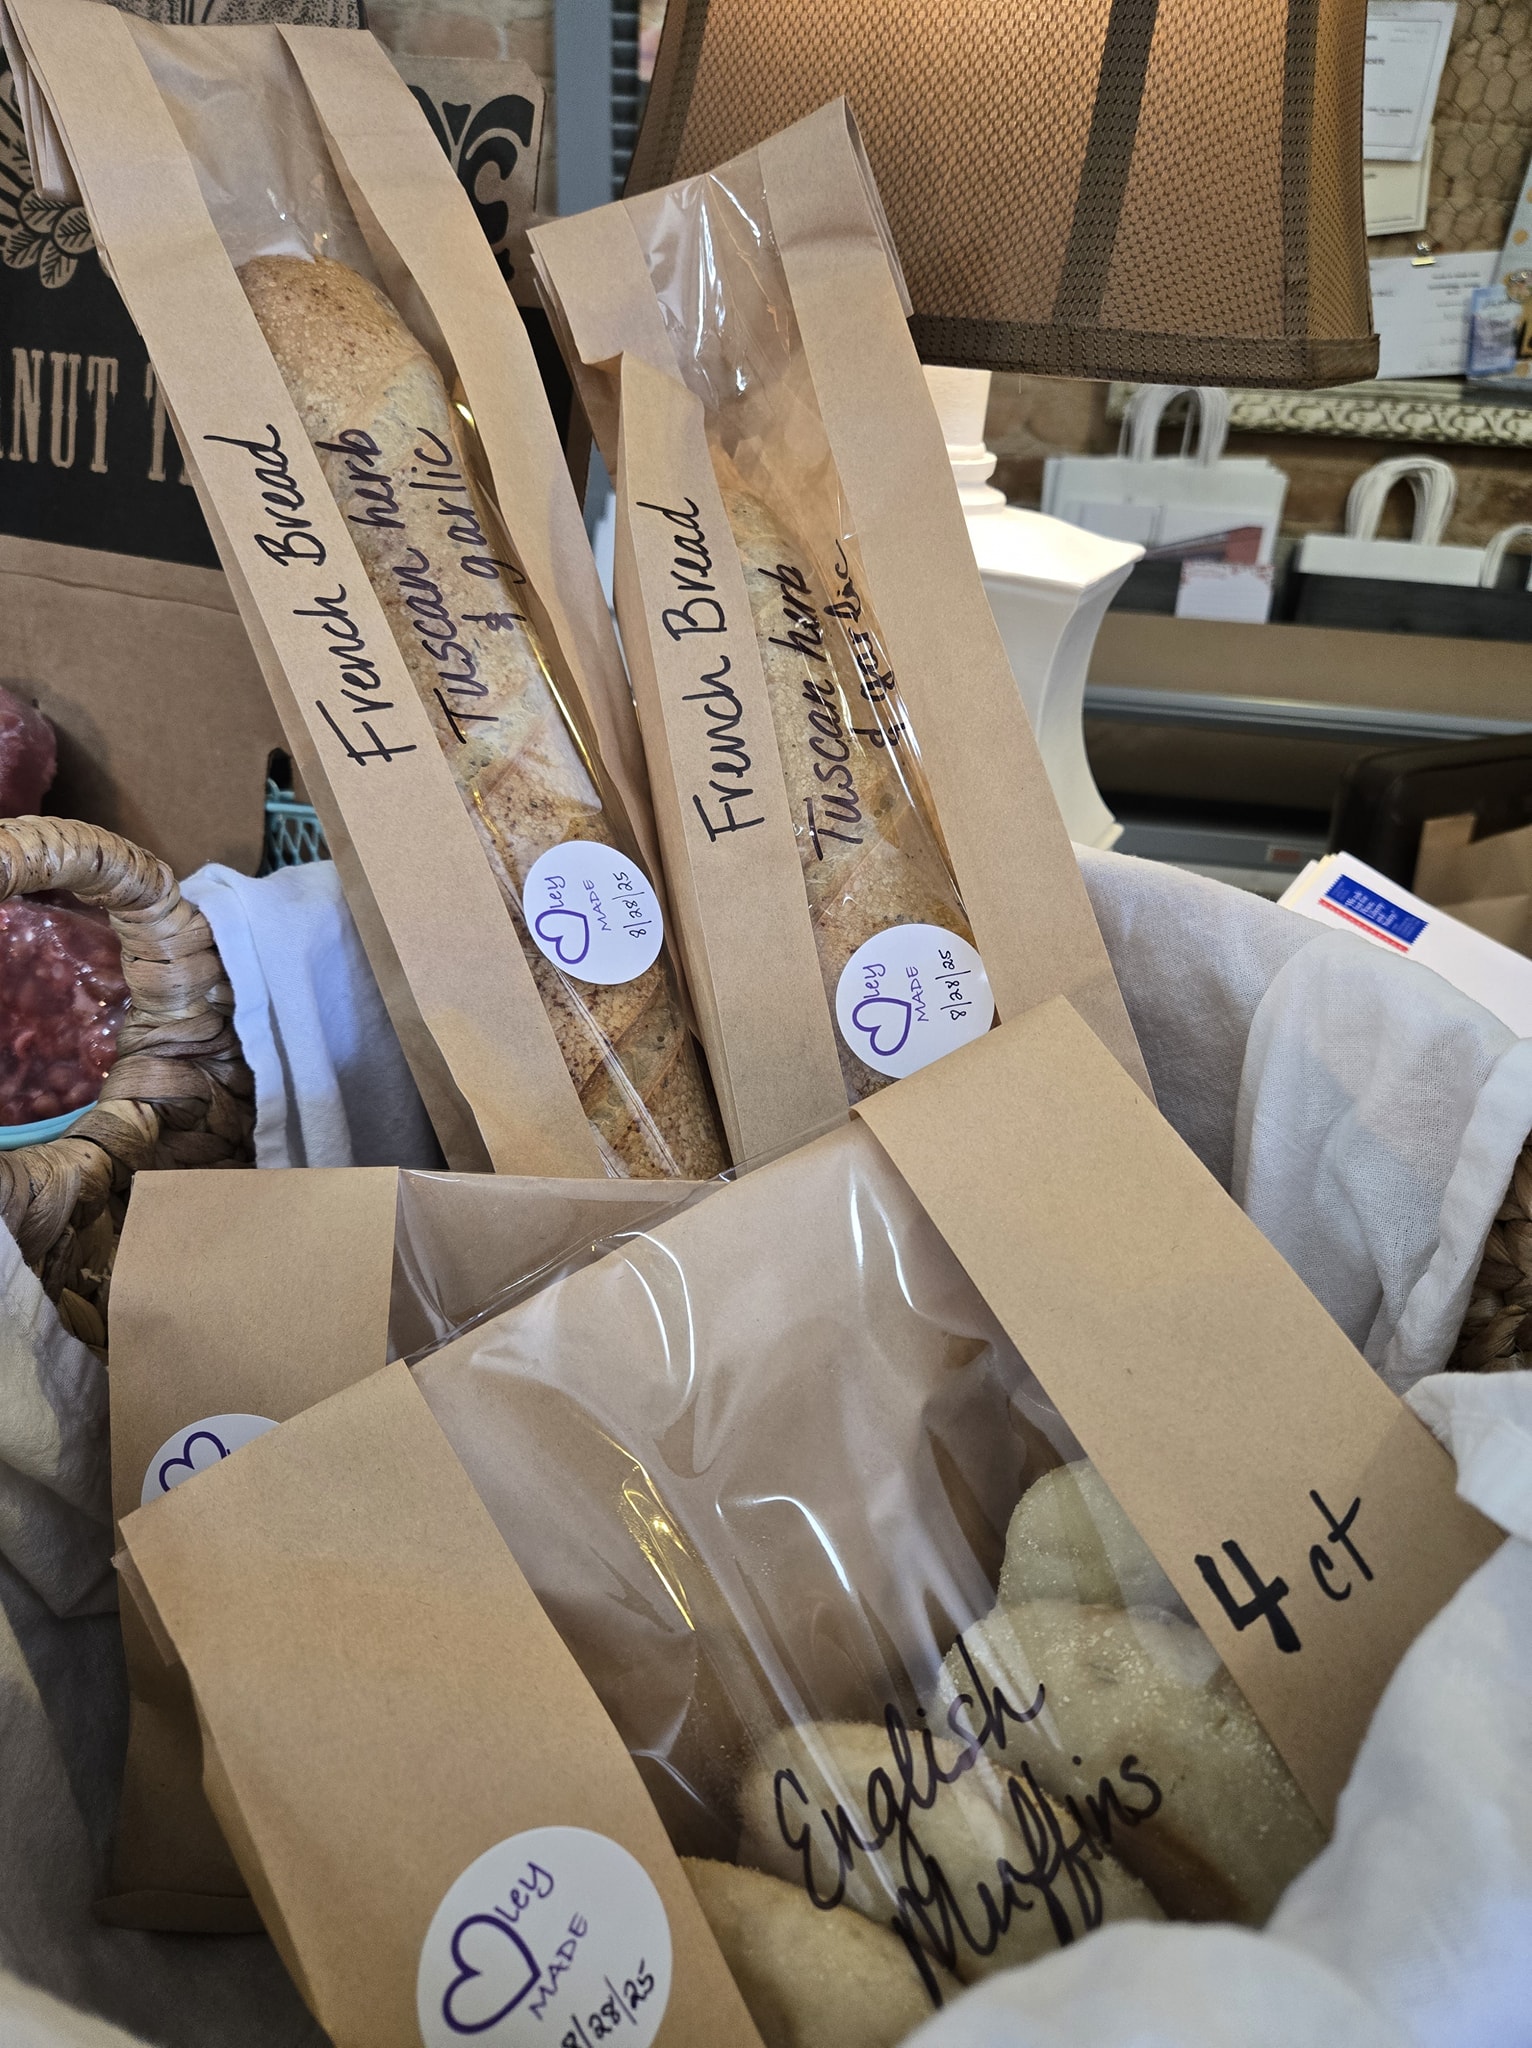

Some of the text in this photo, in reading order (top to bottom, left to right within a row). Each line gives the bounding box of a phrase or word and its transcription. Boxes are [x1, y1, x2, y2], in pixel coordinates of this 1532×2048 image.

[0, 347, 119, 474] NUT
[315, 428, 499, 744] Tuscan herb
[409, 427, 527, 584] garlic
[203, 424, 417, 766] French Bread
[636, 497, 765, 843] French Bread
[823, 539, 895, 702] garlic
[758, 563, 864, 861] Tuscan herb
[583, 879, 611, 931] MADE
[612, 871, 652, 938] 8/28/25
[935, 949, 972, 1020] 8/28/25
[906, 965, 929, 1022] MADE
[1194, 1489, 1374, 1654] 4 ct
[774, 1633, 1045, 1908] English
[891, 1754, 1162, 2009] Muffins
[528, 1911, 588, 2021] MADE
